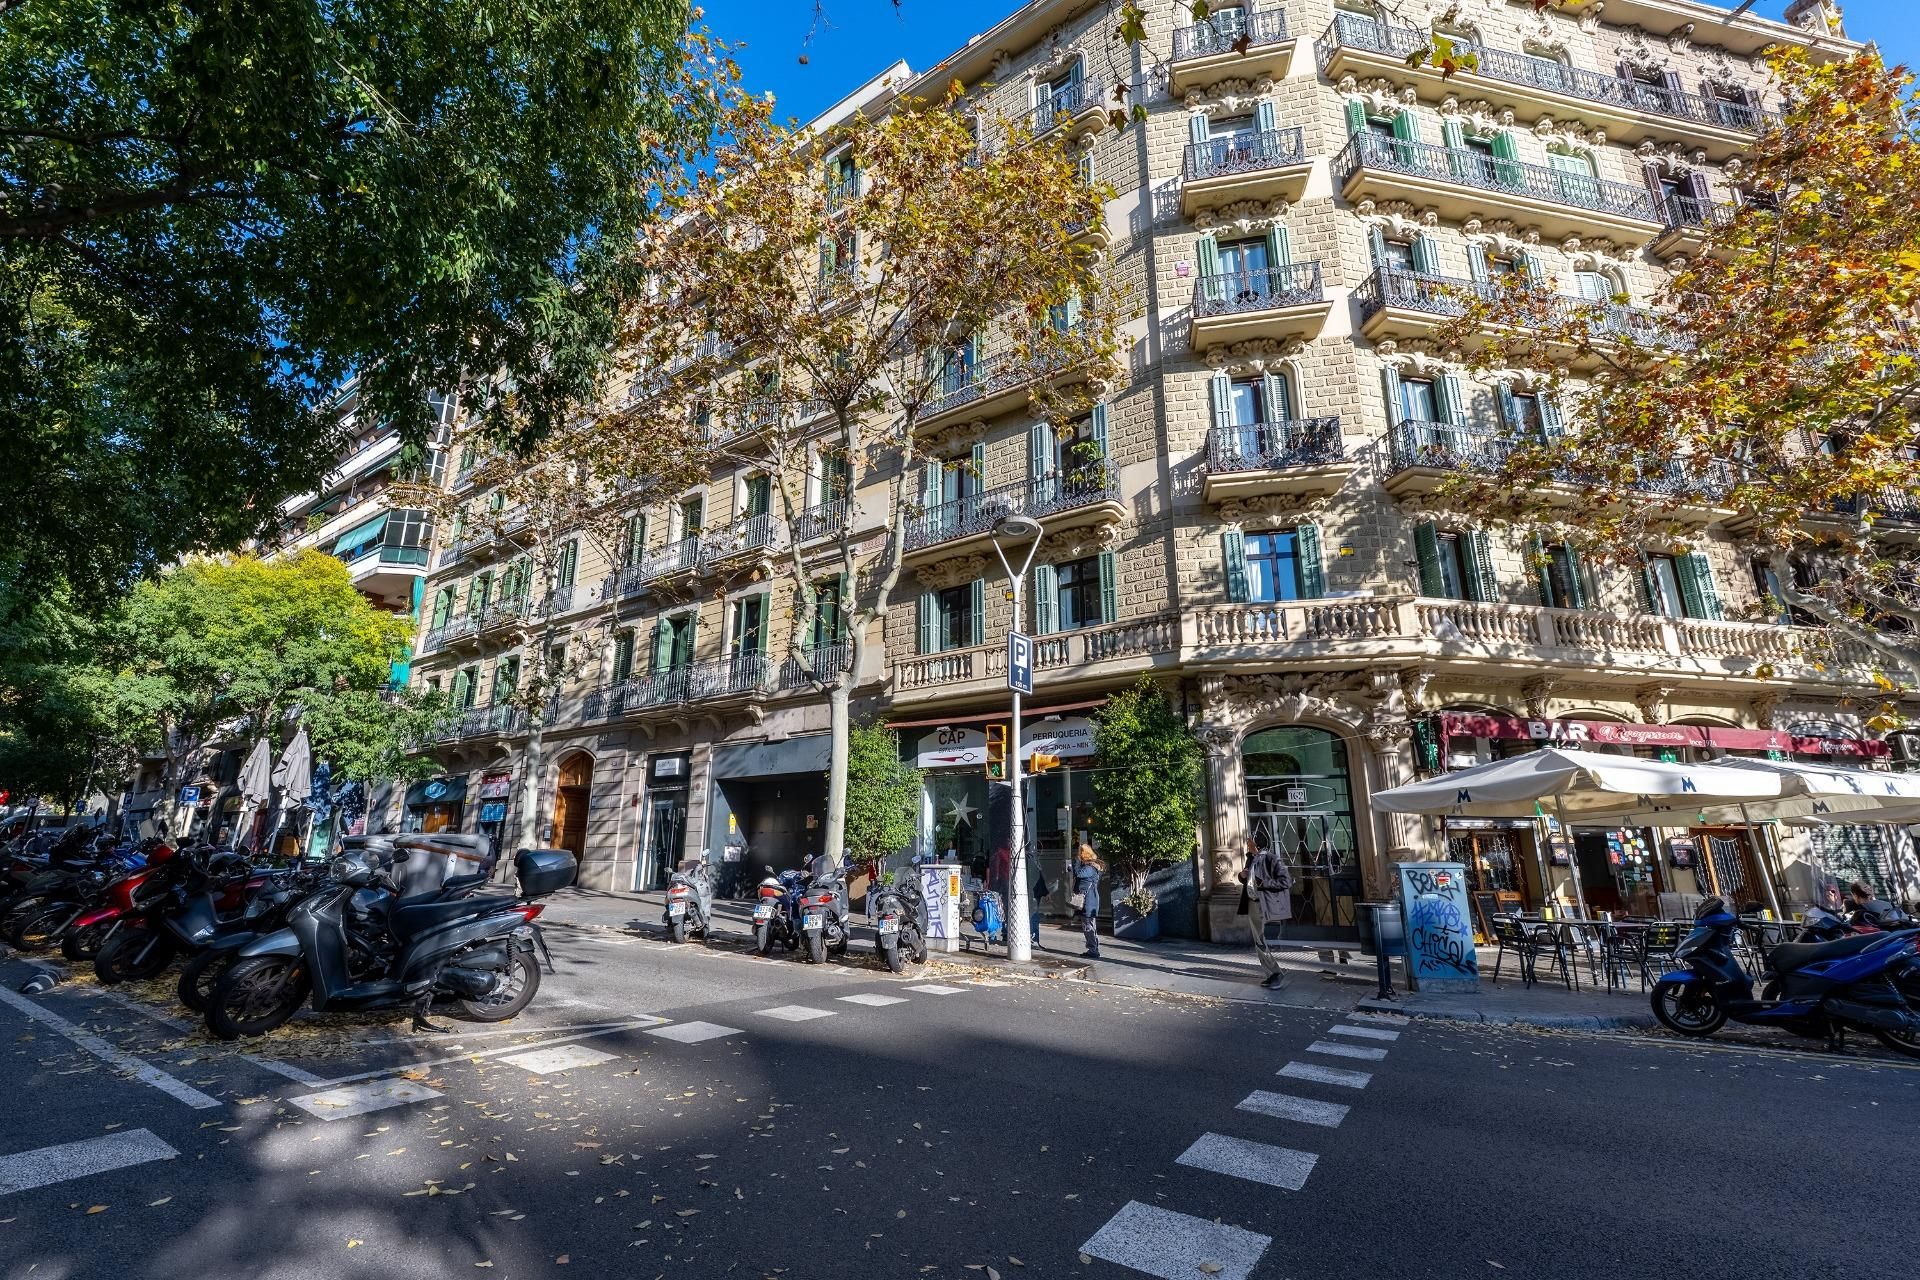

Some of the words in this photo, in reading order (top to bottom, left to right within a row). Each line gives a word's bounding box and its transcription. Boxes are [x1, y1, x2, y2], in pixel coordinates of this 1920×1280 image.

[1015, 641, 1026, 662] P
[938, 730, 966, 745] CAP
[1032, 728, 1088, 741] PERRUQUERIA
[1528, 721, 1589, 741] BAR
[184, 788, 196, 801] P
